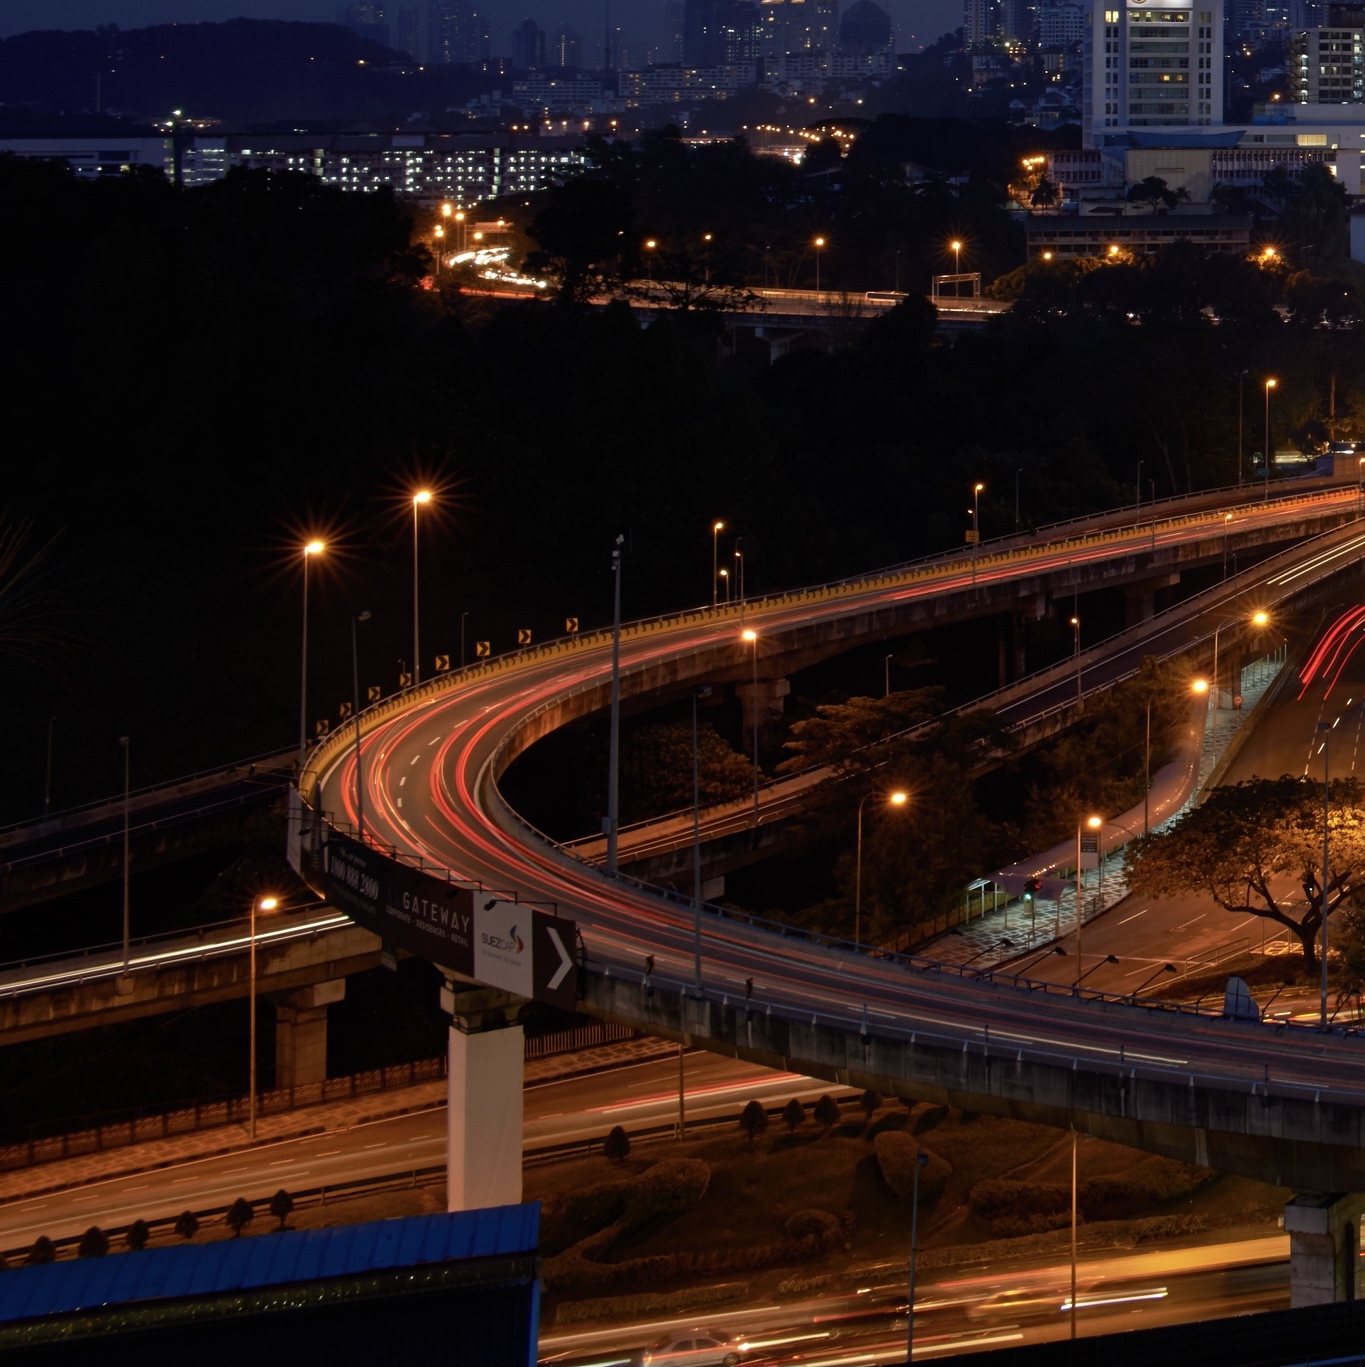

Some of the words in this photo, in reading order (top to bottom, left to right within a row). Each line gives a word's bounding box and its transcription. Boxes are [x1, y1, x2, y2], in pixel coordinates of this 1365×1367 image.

[385, 905, 411, 924] CORPORATE
[416, 919, 446, 938] RESIDENCES
[451, 933, 469, 947] RETAIL
[403, 892, 469, 933] GATEWAY
[481, 933, 516, 952] SUEZCAP
